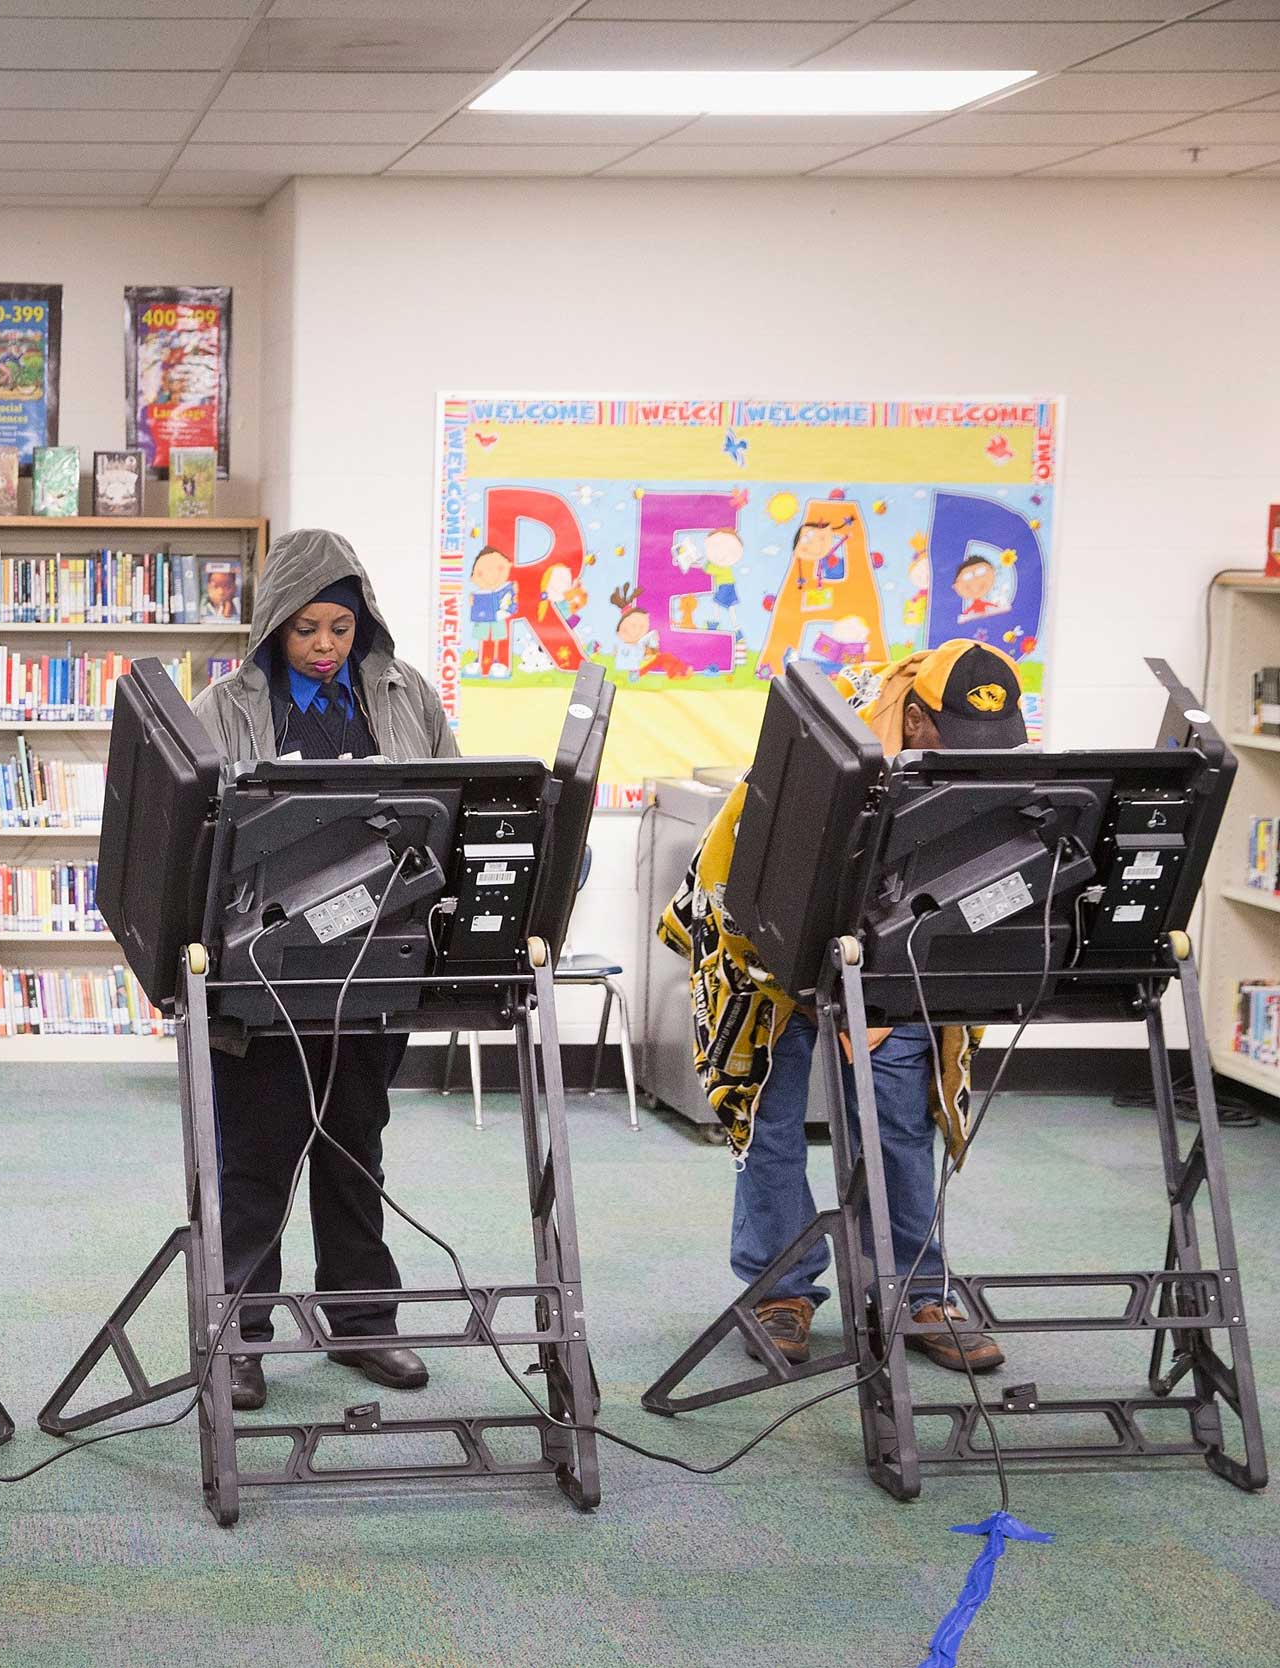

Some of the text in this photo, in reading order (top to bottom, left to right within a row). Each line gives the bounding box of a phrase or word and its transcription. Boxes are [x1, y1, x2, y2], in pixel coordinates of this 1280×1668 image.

[142, 309, 216, 327] 400-99
[474, 403, 594, 419] WELCOME
[748, 405, 868, 421] WELCOME
[914, 405, 1035, 422] WELCOME
[445, 429, 463, 550] WELCOME
[478, 485, 1045, 678] READ
[442, 597, 459, 716] WELCOME
